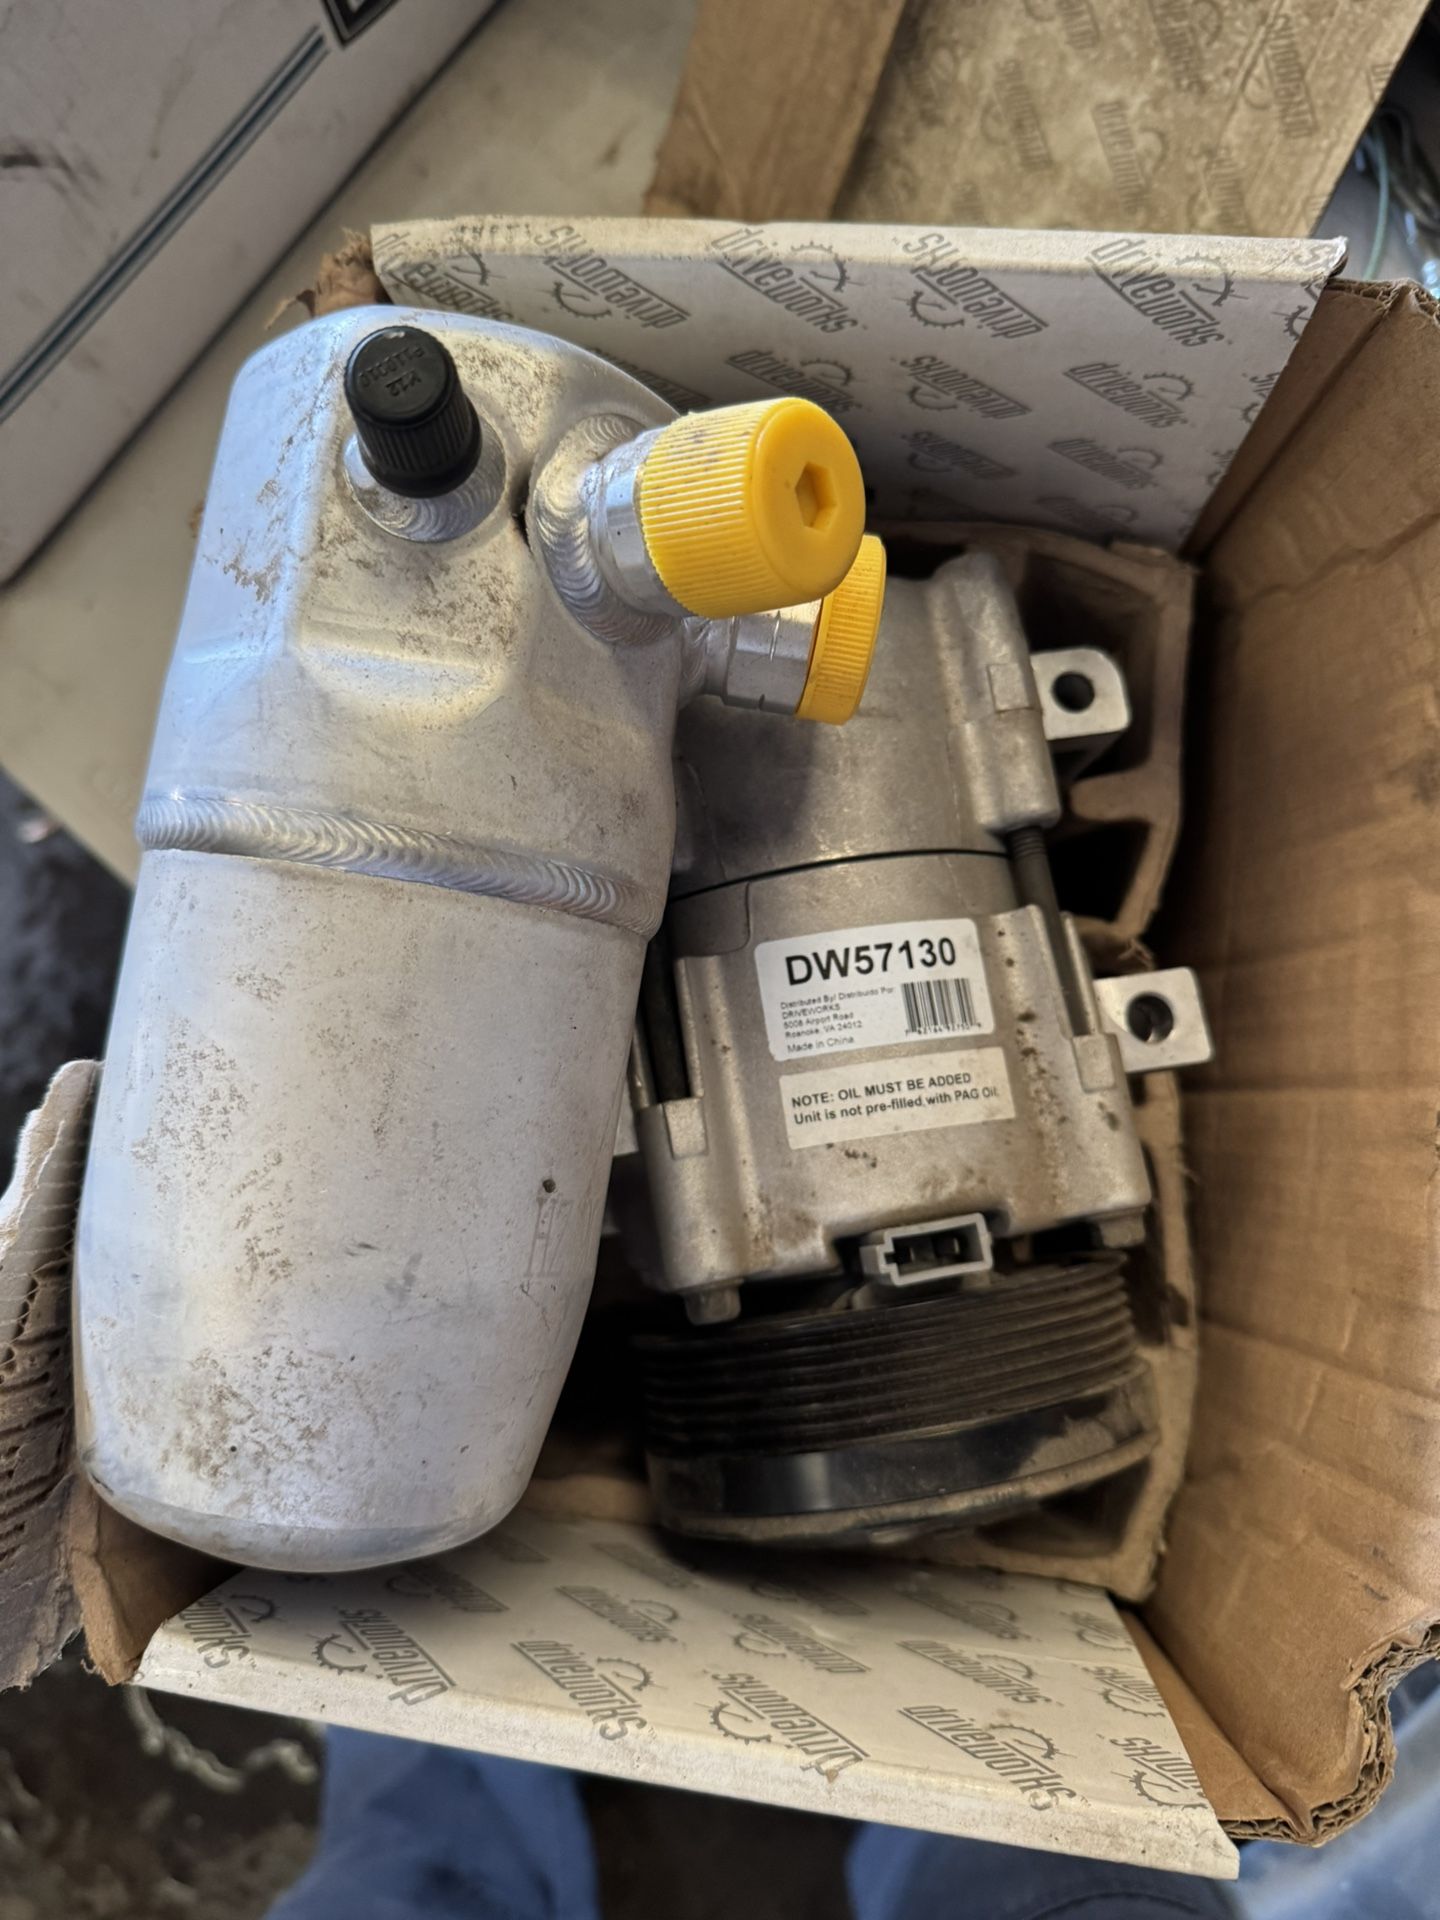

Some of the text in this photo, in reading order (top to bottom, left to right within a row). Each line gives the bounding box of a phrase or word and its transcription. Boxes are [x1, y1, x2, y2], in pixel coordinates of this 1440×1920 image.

[534, 225, 689, 329] driveworks
[713, 228, 858, 333] driveworks
[902, 233, 1044, 339] driveworks
[1089, 238, 1225, 347] driveworks
[900, 356, 1030, 419] driveworks
[1066, 362, 1188, 429] driveworks
[785, 937, 956, 986] DW57130
[780, 995, 822, 1010] Distributed
[782, 1003, 841, 1020] DRIVEWORKS
[806, 1015, 831, 1026] Airport
[833, 1012, 854, 1021] Road
[787, 1036, 855, 1053] Made in China
[791, 1072, 972, 1108] NOTE: OIL MUST BE ADDED
[794, 1110, 822, 1125] Unit
[824, 1108, 837, 1120] is
[840, 1105, 863, 1118] not
[865, 1095, 923, 1115] pre-filled
[925, 1089, 952, 1105] with
[954, 1086, 980, 1101] PAG
[338, 1608, 452, 1706] driveworks
[898, 1640, 1053, 1704] driveworks
[515, 1640, 647, 1741] driveworks
[712, 1672, 865, 1776] driveworks
[900, 1704, 1077, 1811] driveworks
